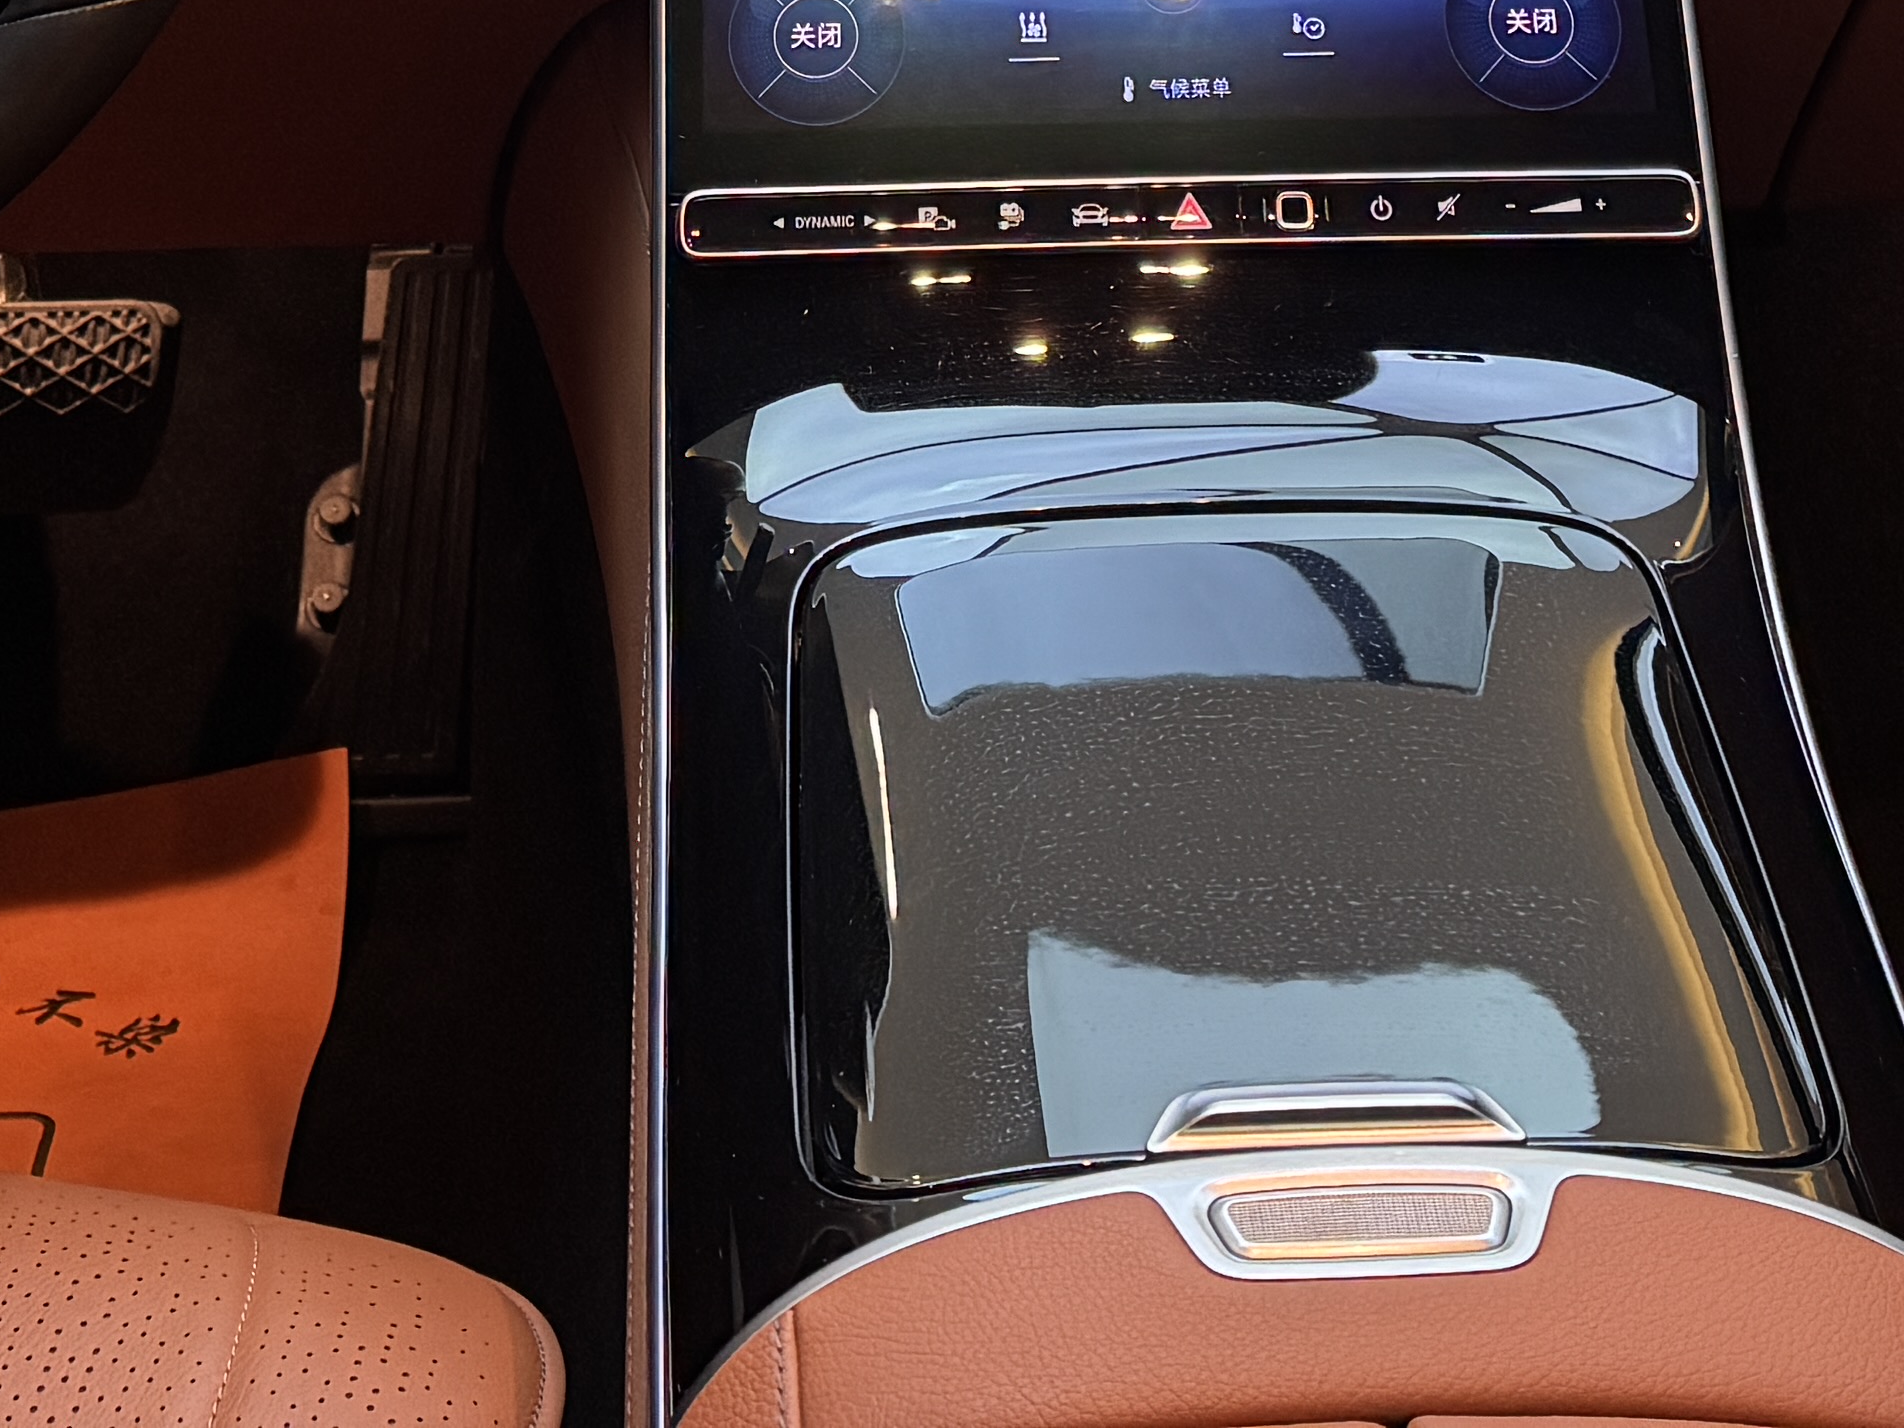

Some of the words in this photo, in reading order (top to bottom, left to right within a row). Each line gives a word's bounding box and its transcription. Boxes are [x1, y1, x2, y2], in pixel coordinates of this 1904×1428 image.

[1506, 8, 1557, 35] 关闭
[790, 22, 842, 49] 关闭
[1149, 78, 1232, 99] 气候菜单
[795, 215, 855, 229] DYNAMIC
